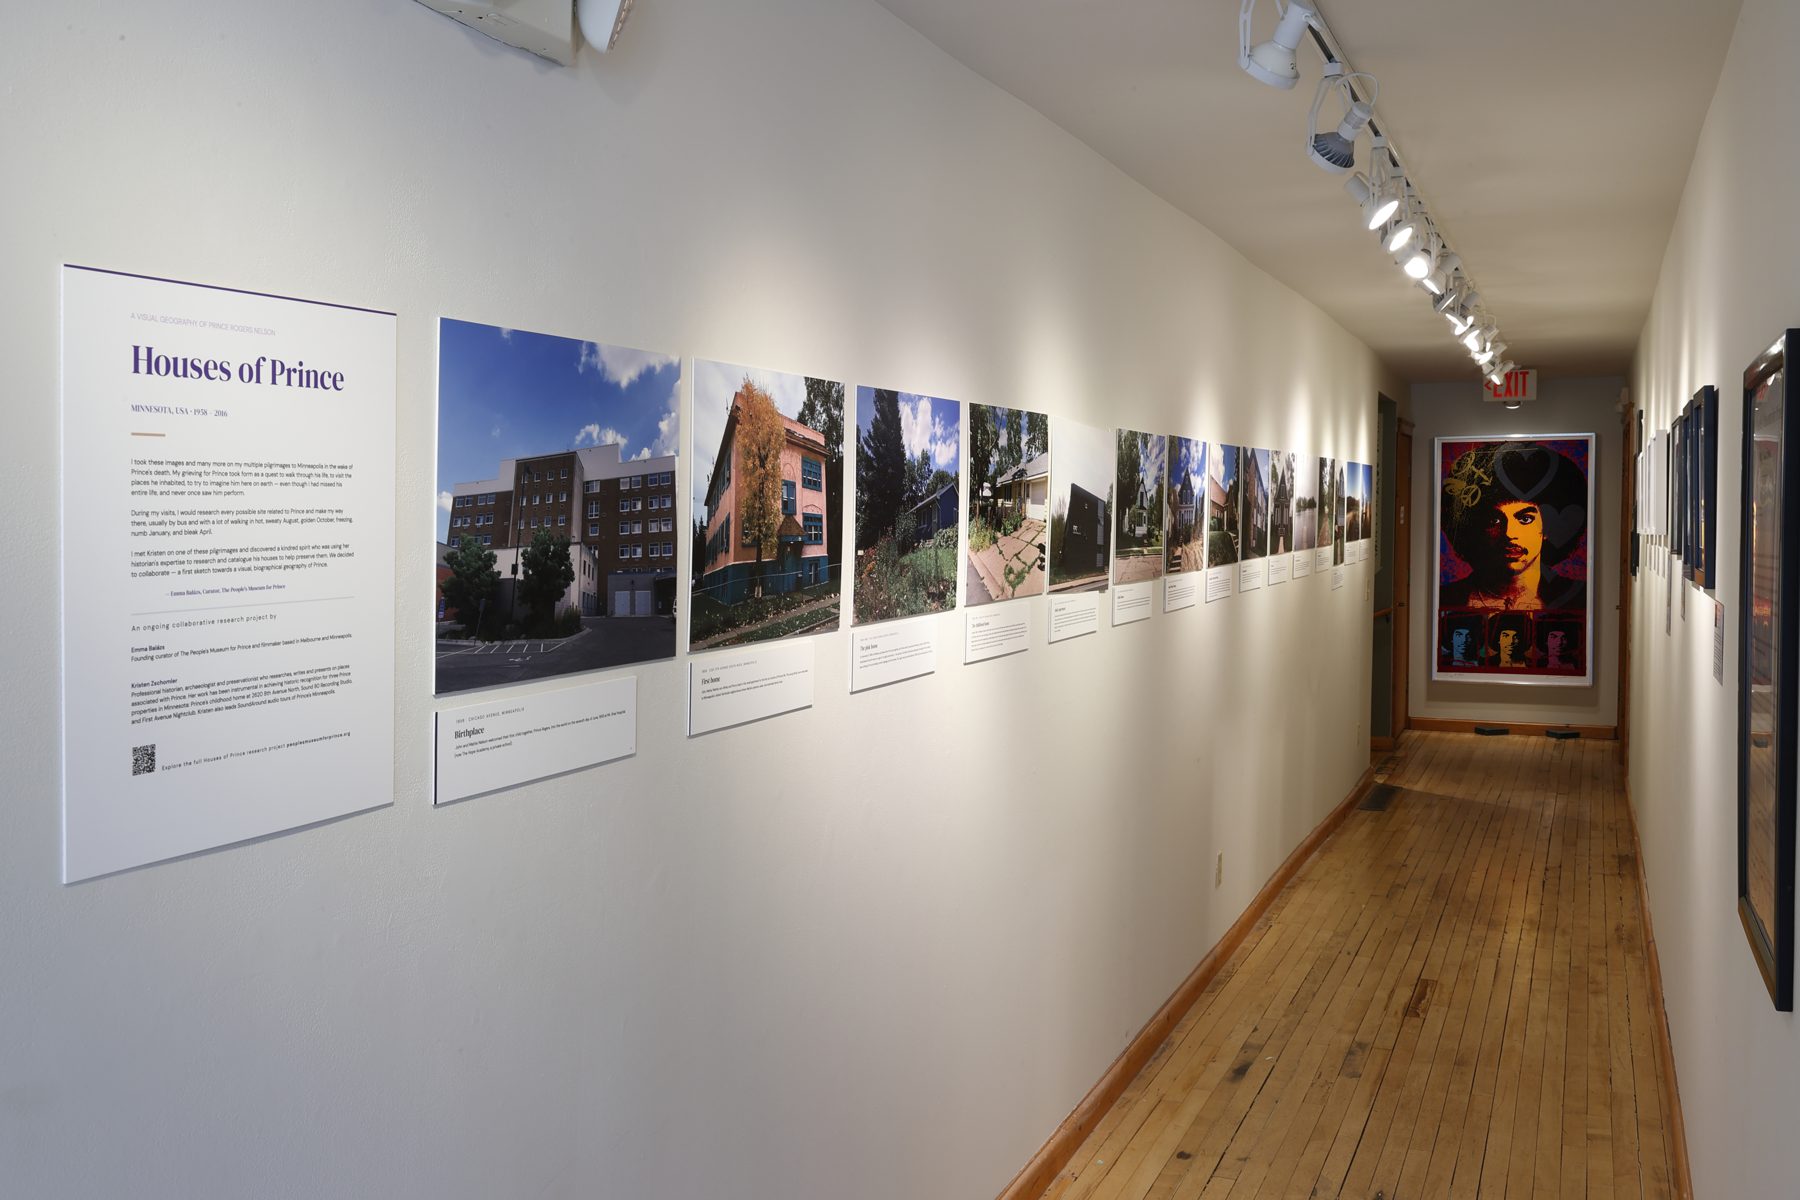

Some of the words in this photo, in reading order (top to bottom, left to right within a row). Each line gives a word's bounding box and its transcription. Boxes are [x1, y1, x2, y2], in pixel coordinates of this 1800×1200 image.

[131, 345, 232, 382] Houses
[238, 356, 267, 384] of
[270, 358, 345, 391] Prince
[175, 407, 188, 415] USA
[193, 408, 207, 416] 1958
[214, 409, 227, 417] 2016
[164, 459, 184, 467] images
[243, 461, 263, 469] multiple
[209, 548, 238, 556] pilgrimages
[160, 559, 185, 567] expertise
[138, 569, 169, 577] collaborate
[253, 564, 282, 572] biographical
[142, 623, 169, 632] ongoing
[171, 619, 215, 628] collaborative
[216, 616, 244, 624] research
[245, 614, 267, 624] project
[130, 654, 154, 662] Founding
[189, 648, 209, 656] People's
[130, 687, 161, 697] Professional
[141, 715, 153, 723] First
[454, 727, 485, 739] Birthplace
[161, 763, 181, 771] Explore
[246, 746, 267, 755] research
[268, 743, 285, 753] project
